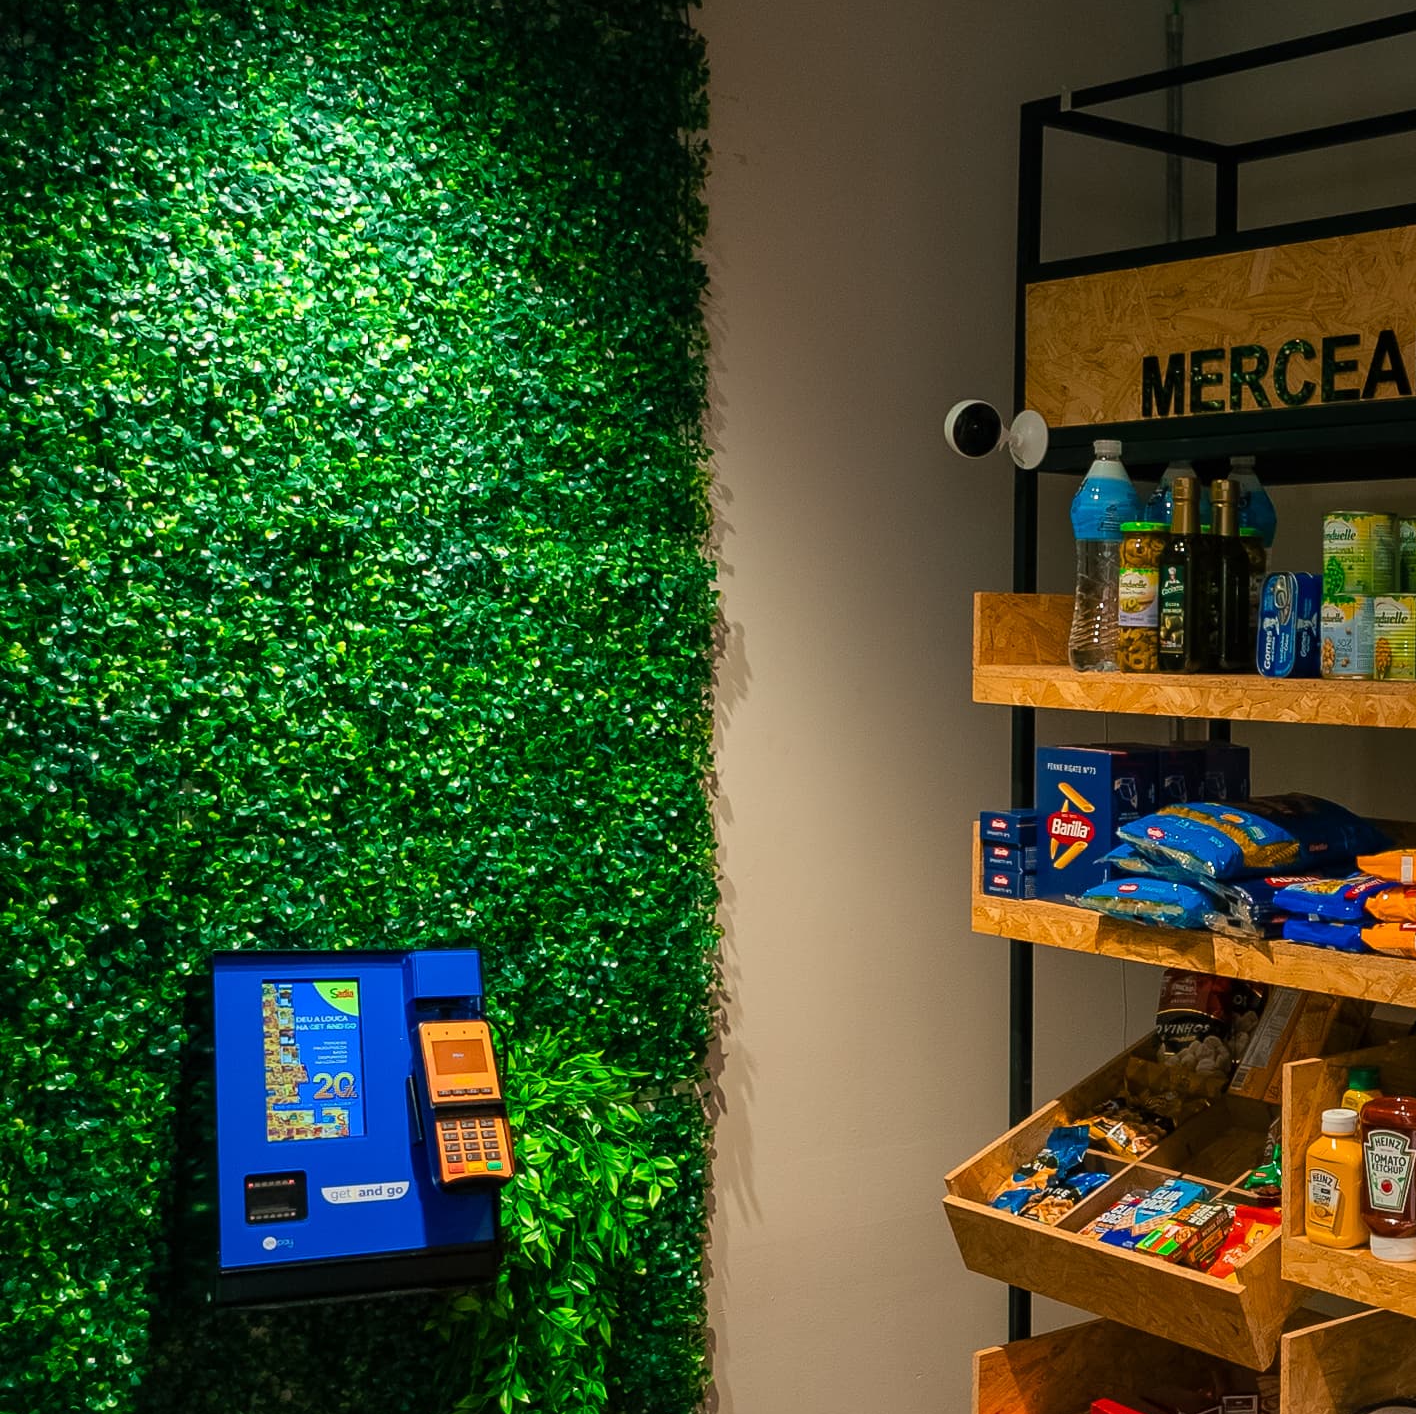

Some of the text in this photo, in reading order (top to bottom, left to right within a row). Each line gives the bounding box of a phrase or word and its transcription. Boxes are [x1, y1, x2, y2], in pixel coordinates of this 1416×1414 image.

[1051, 818, 1090, 839] Barilla
[1375, 1137, 1401, 1149] HEINZ
[1370, 1152, 1407, 1167] TOMATO
[1371, 1163, 1405, 1175] KETCHUP
[1313, 1173, 1333, 1187] HEINZ
[330, 1187, 404, 1201] get and go
